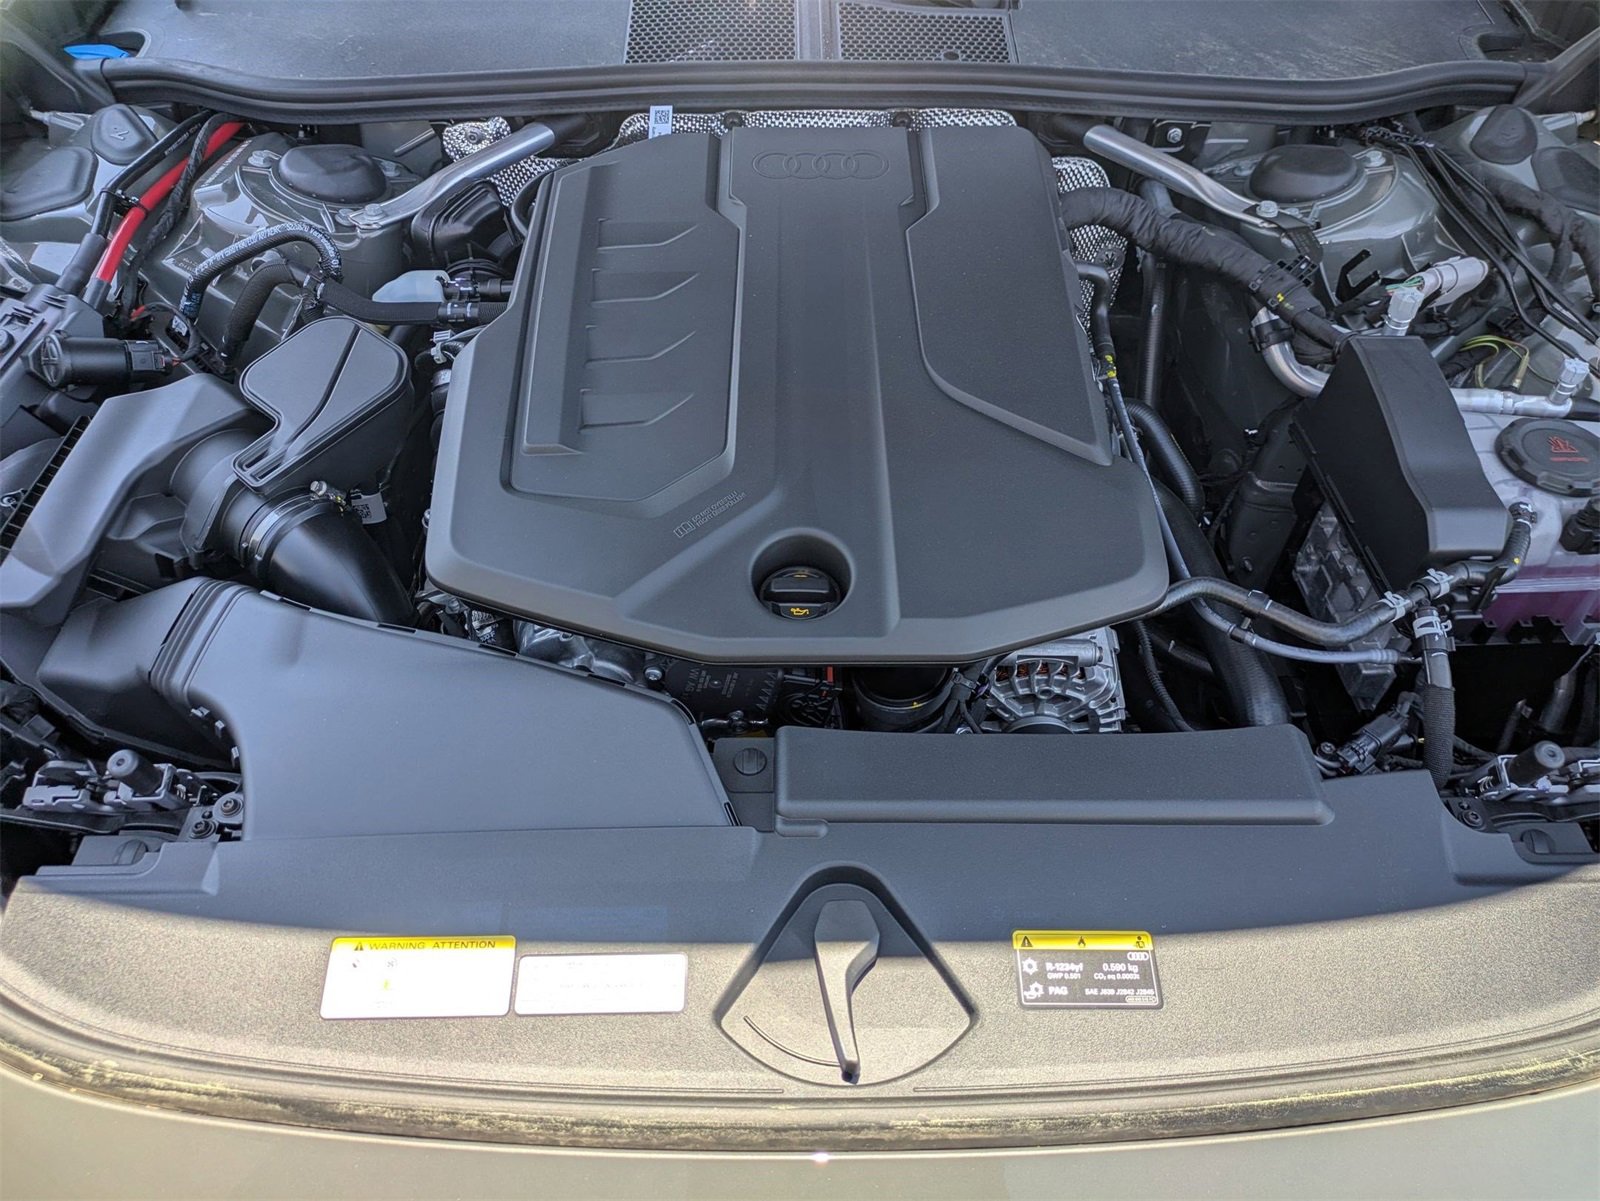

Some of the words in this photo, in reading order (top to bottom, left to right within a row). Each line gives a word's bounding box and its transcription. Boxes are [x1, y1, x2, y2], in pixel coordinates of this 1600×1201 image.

[369, 941, 426, 950] WARNING
[433, 940, 496, 949] ATTENTION
[1127, 962, 1139, 973] kg
[1048, 986, 1069, 996] PAG
[1085, 988, 1099, 996] SAE
